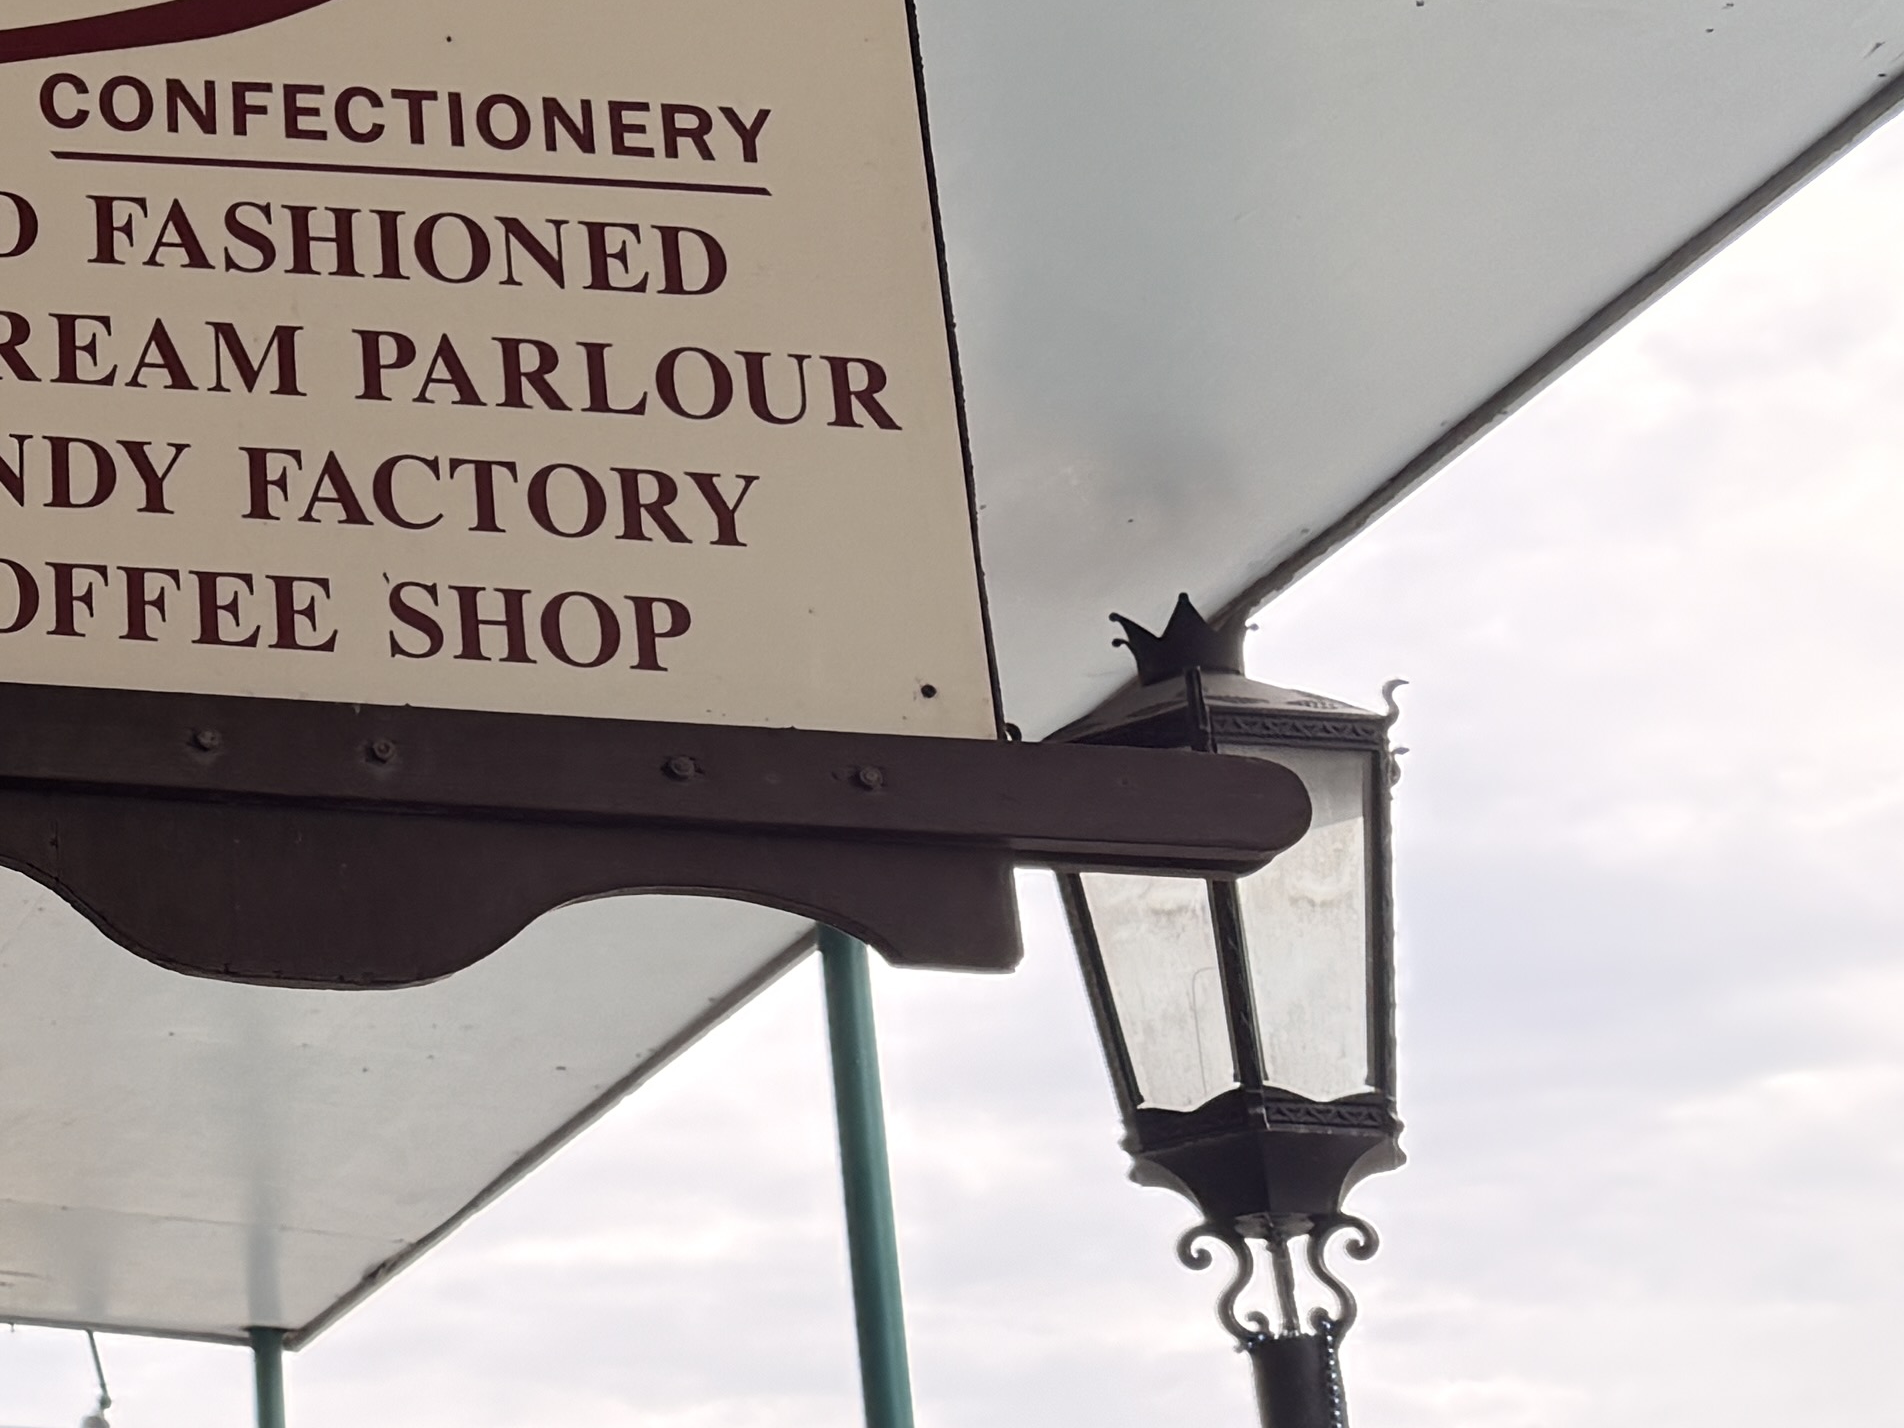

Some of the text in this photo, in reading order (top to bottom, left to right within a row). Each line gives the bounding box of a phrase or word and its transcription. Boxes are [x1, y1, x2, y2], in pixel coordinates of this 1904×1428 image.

[38, 72, 773, 164] CONFECTIONERY
[85, 194, 729, 296] FASHIONED
[351, 328, 903, 432] PARLOUR
[238, 446, 761, 548] FACTORY
[389, 578, 693, 674] SHOP
